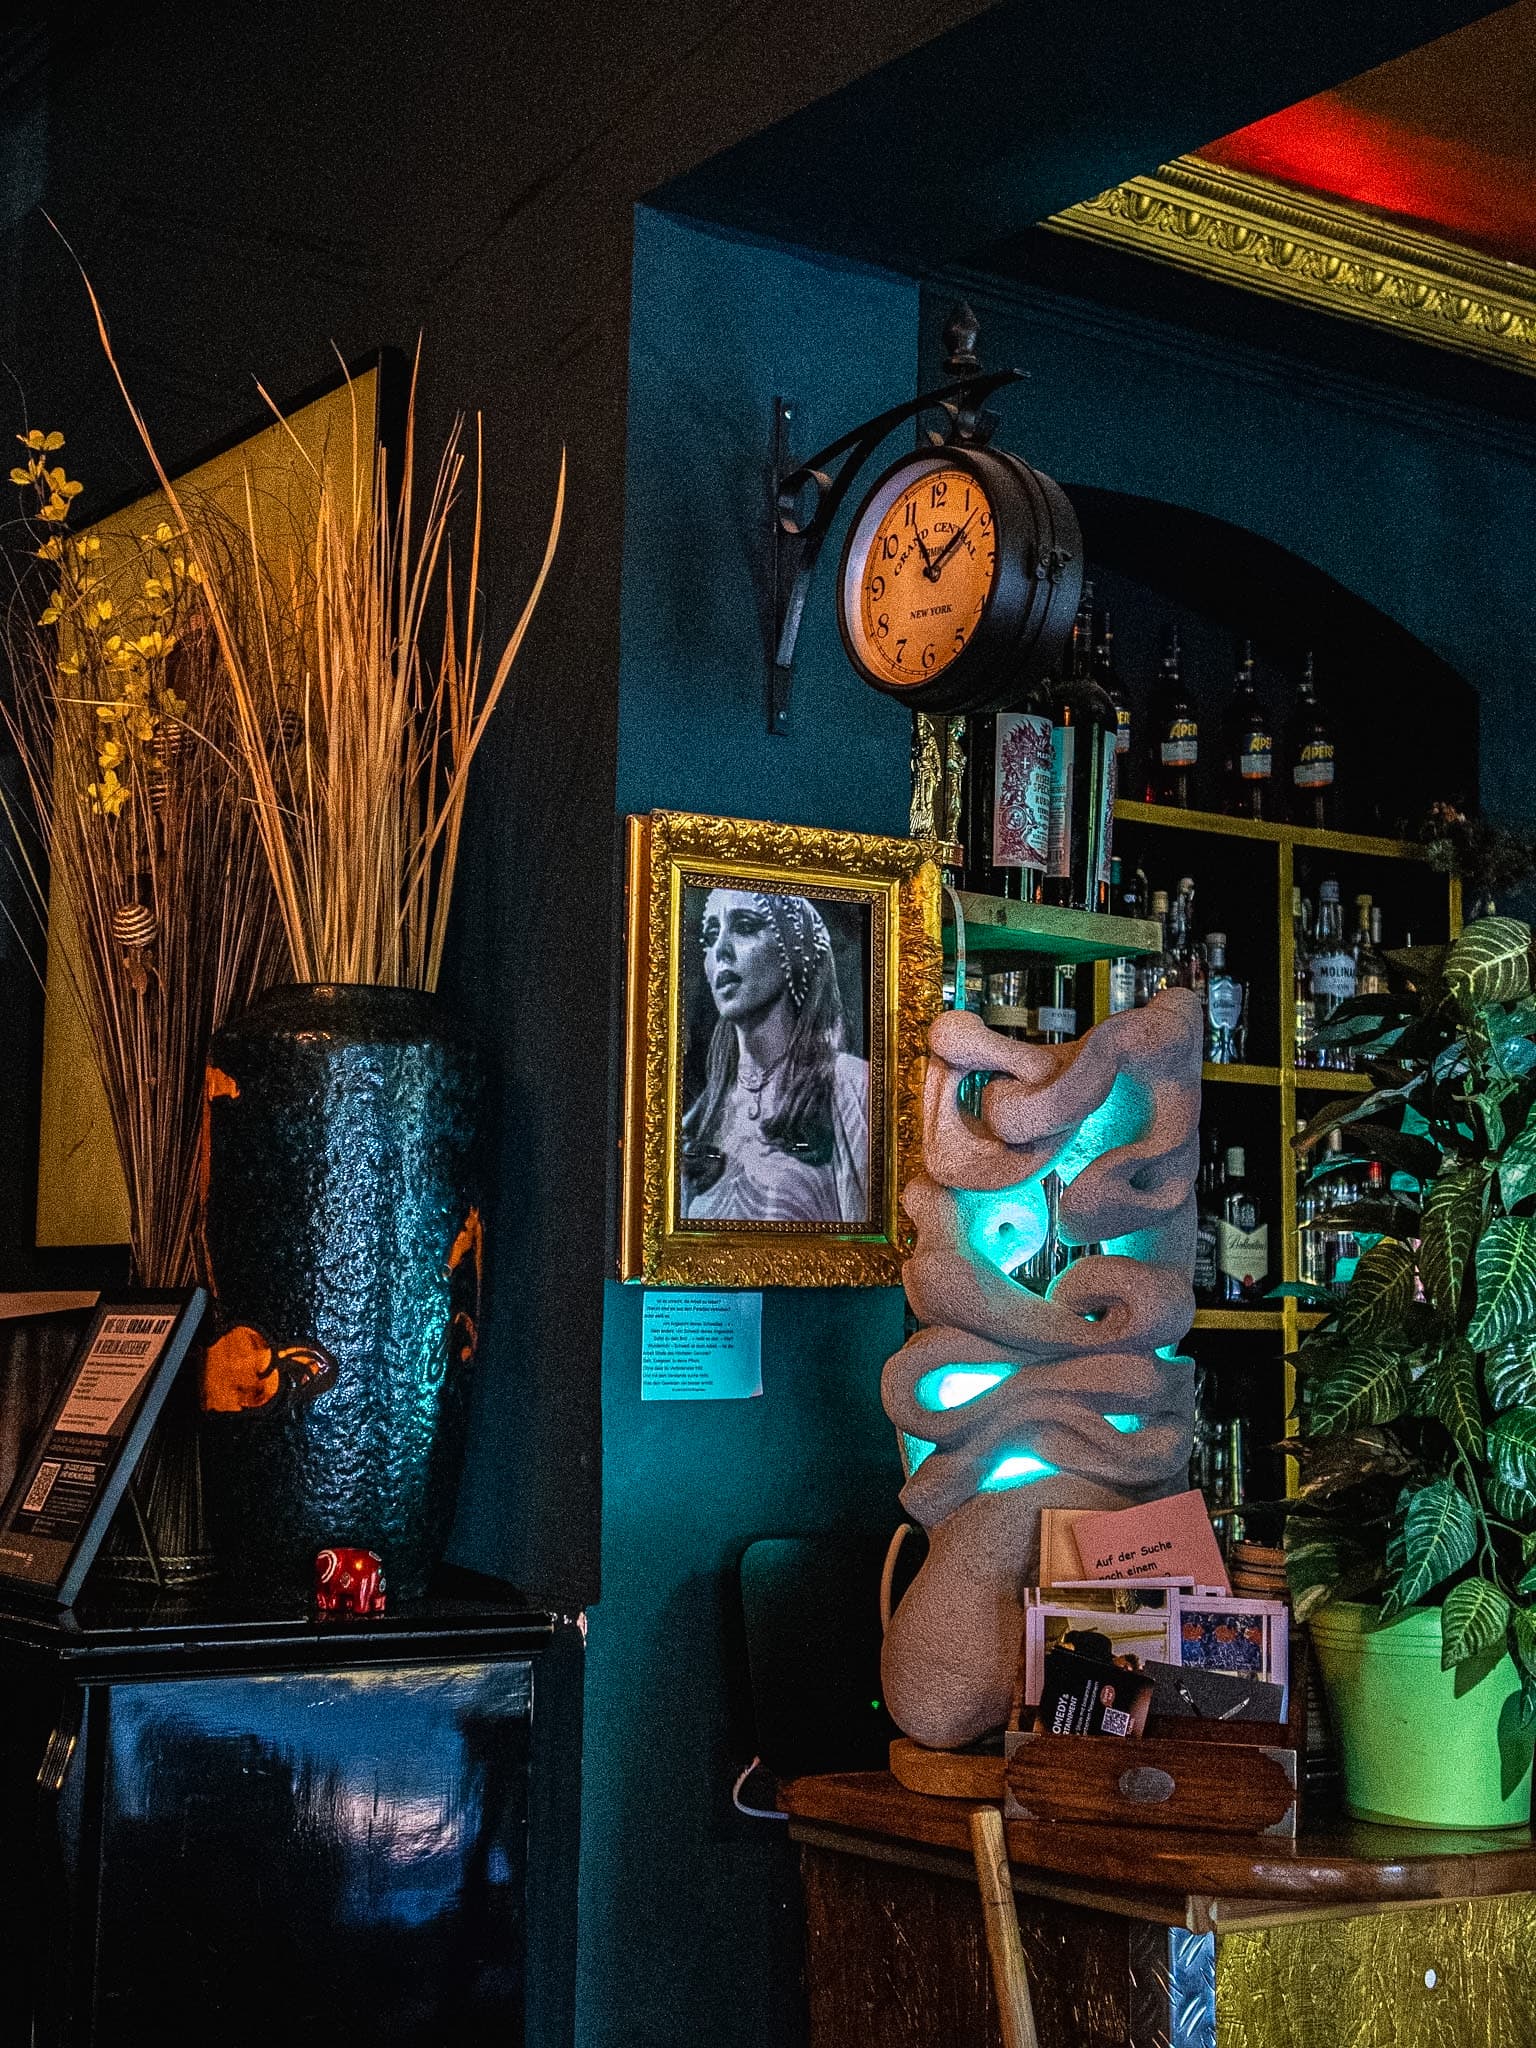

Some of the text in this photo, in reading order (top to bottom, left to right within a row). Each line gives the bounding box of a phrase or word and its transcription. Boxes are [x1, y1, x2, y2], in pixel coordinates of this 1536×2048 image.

[930, 482, 947, 508] 12
[965, 488, 970, 512] 1
[905, 501, 917, 528] 11
[980, 512, 992, 538] 2
[882, 534, 899, 560] 10
[871, 575, 885, 601] 9
[910, 604, 953, 619] NEW YORK
[877, 613, 889, 638] 8
[895, 638, 907, 664] 7
[952, 627, 965, 654] 5
[921, 643, 935, 669] 6
[126, 1319, 157, 1334] URBAN
[152, 1320, 172, 1335] ART
[1096, 1541, 1172, 1569] Auf der Suche
[1127, 1562, 1157, 1576] einem
